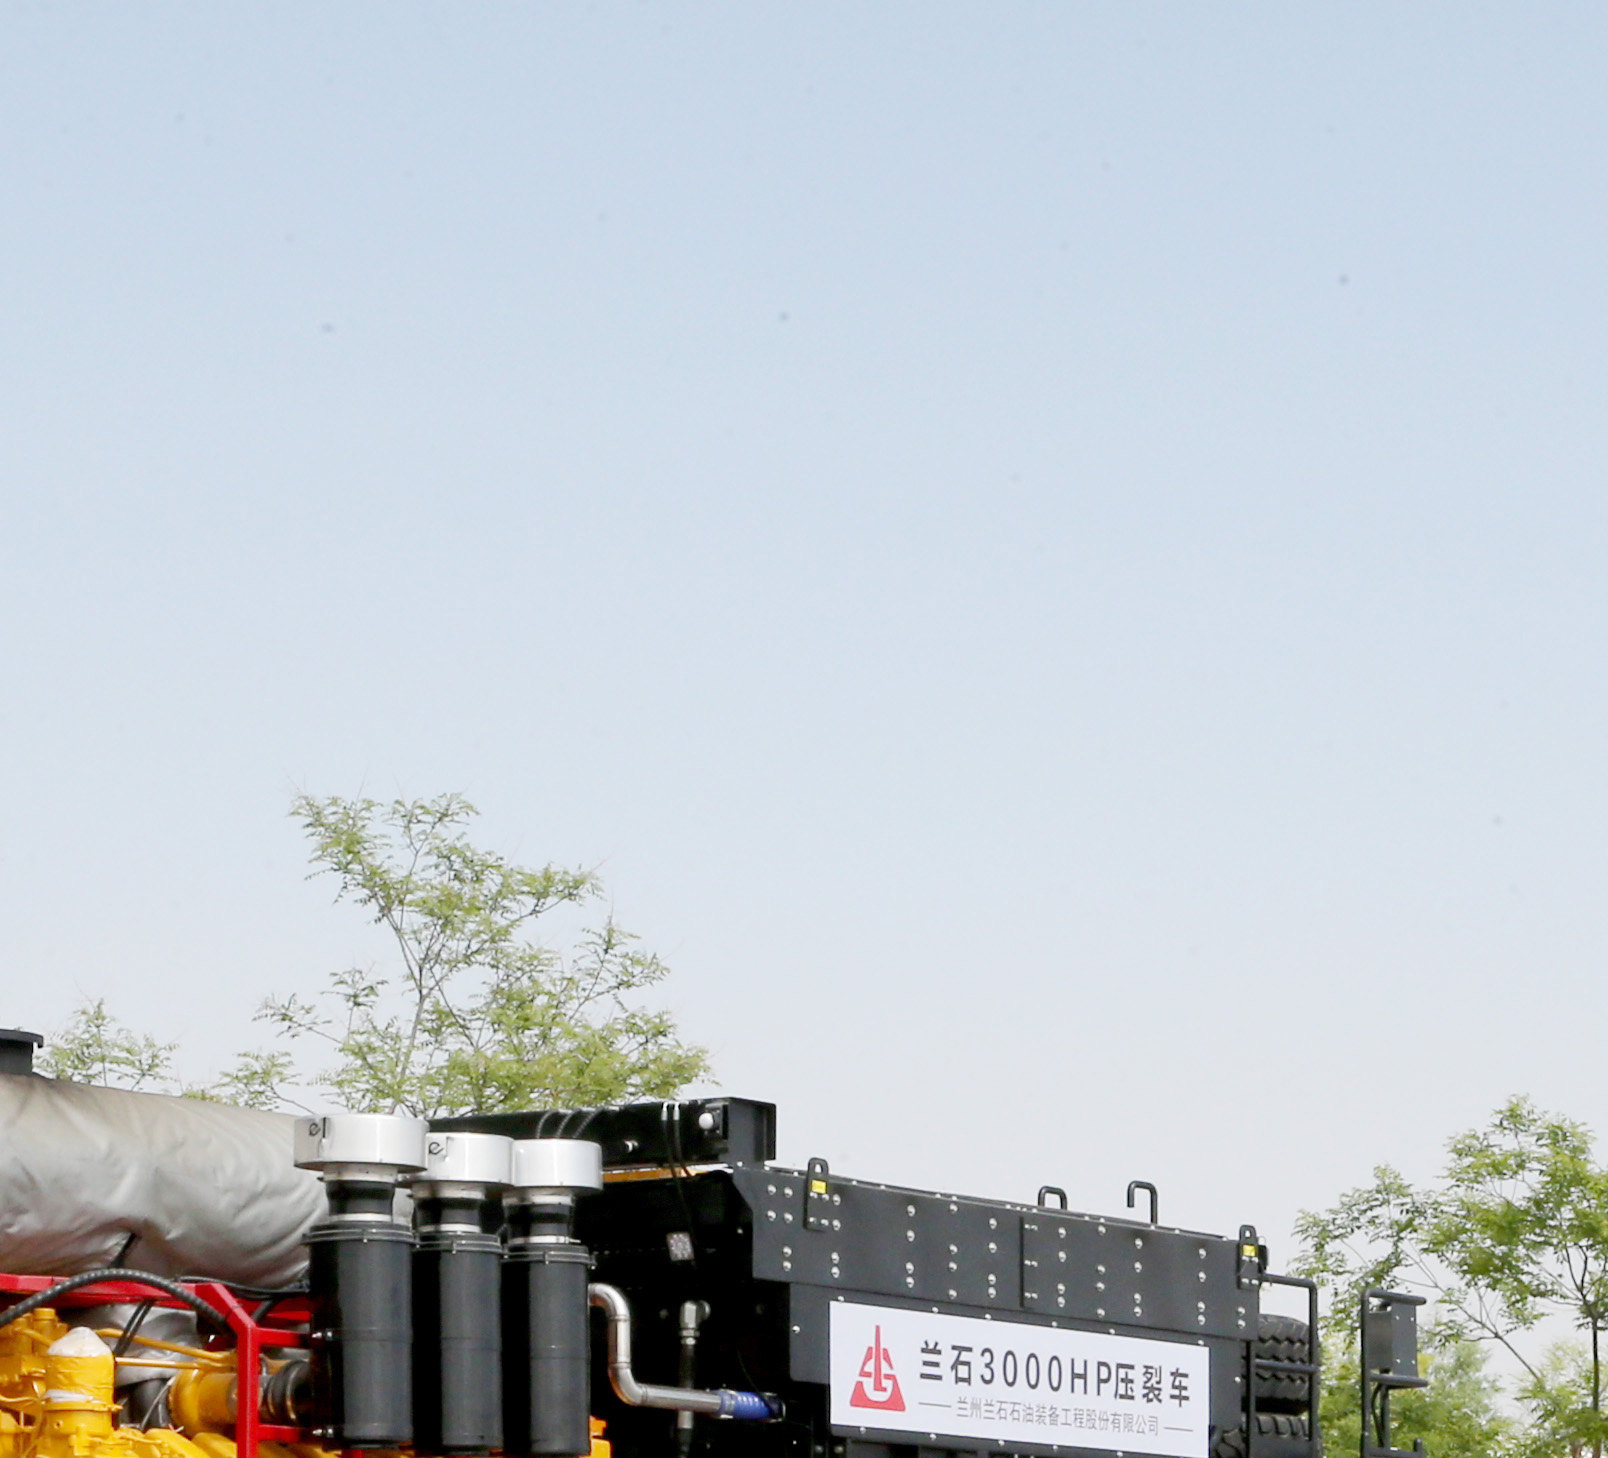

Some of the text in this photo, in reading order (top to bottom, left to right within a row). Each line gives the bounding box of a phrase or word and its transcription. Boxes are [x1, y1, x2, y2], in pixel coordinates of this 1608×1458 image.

[919, 1339, 1192, 1408] 兰石3000HP压裂车
[955, 1395, 1160, 1437] 兰州兰石石油装备工程股份有限公司
